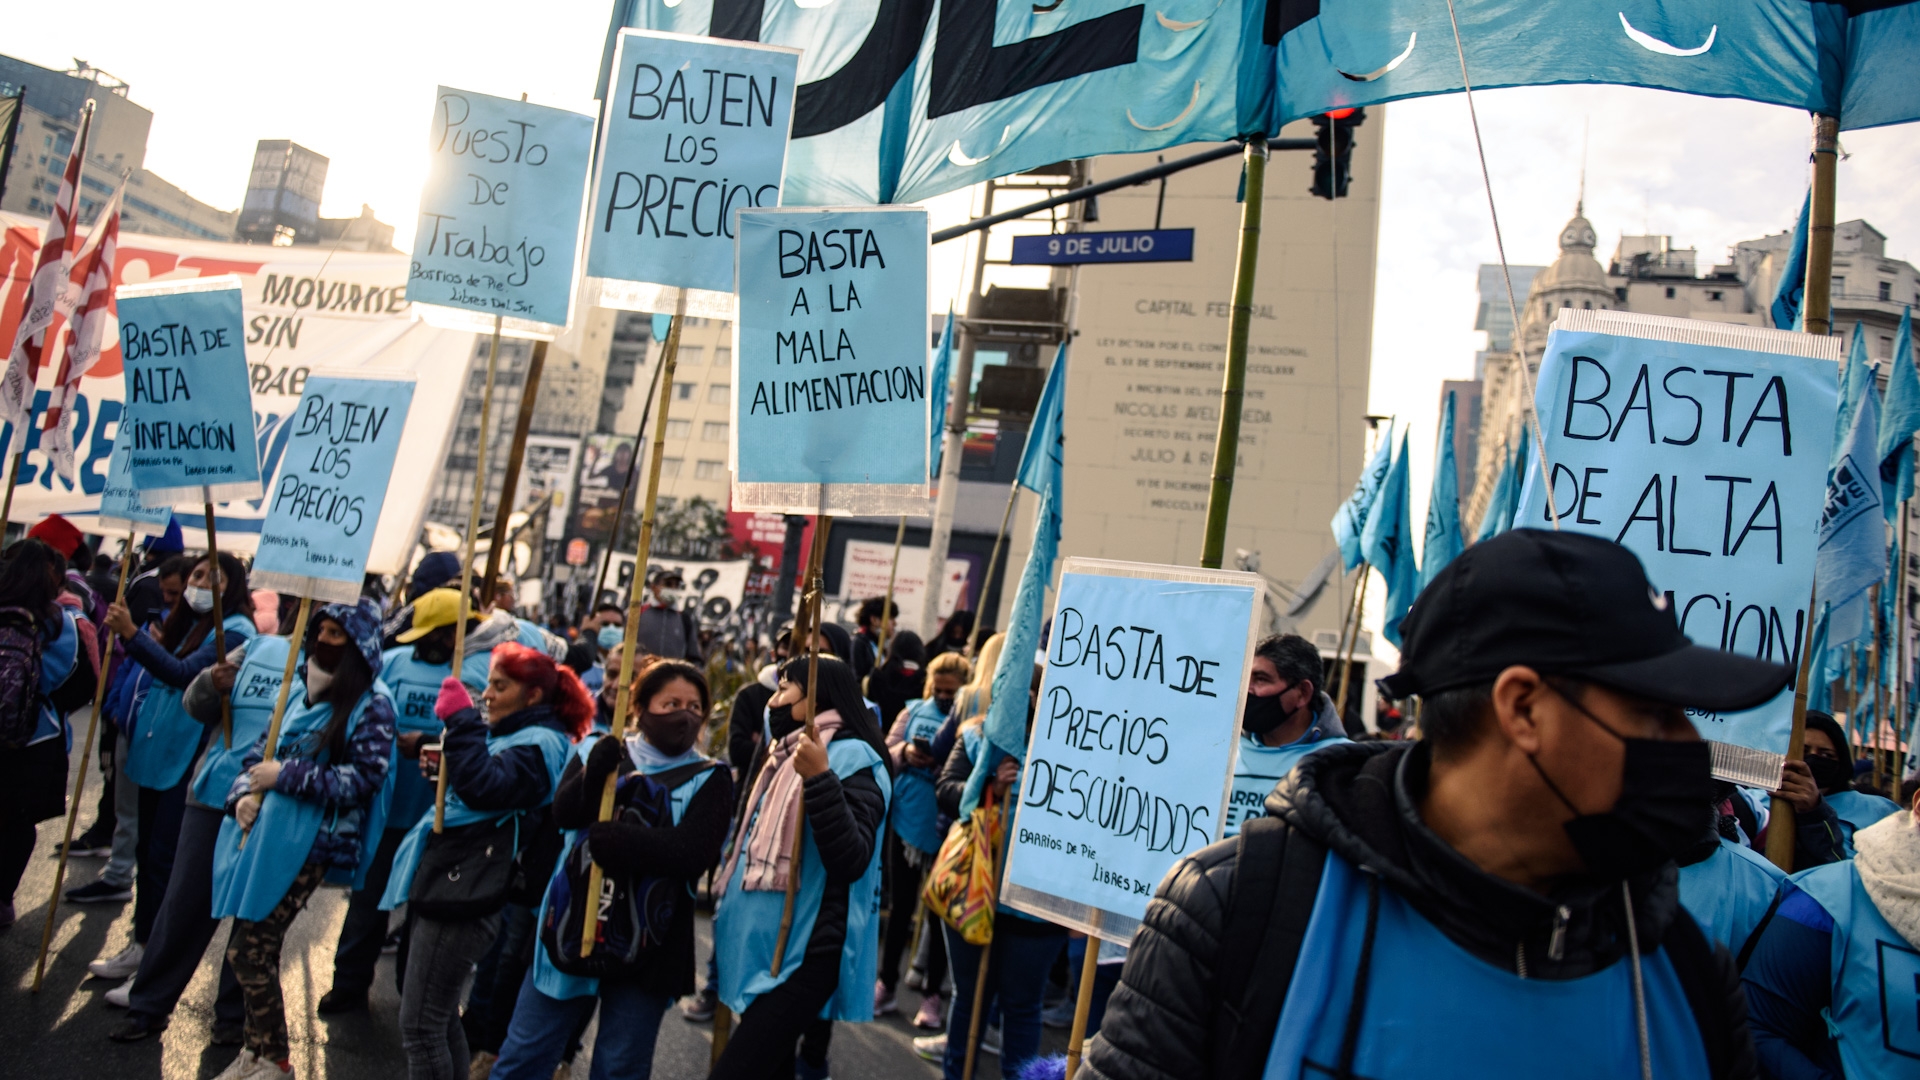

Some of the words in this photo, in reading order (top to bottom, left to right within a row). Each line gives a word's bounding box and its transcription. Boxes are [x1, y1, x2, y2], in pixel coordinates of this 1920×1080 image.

[628, 63, 778, 128] BAJEN
[663, 133, 718, 166] LOS
[422, 212, 545, 287] Trabajo
[779, 228, 886, 279] BASTA
[1048, 239, 1061, 256] 9
[1065, 238, 1092, 255] DE
[1096, 235, 1155, 254] JULIO
[410, 261, 462, 284] Barrios
[466, 274, 481, 288] de
[262, 274, 415, 313] MOVIMIE
[449, 287, 487, 306] Libres
[790, 287, 810, 316] A
[829, 280, 862, 312] LA
[1134, 299, 1197, 317] CAPITAL
[122, 322, 197, 360] BASTA
[200, 328, 231, 351] DE
[247, 315, 303, 350] SIN
[776, 328, 856, 365] MALA
[1159, 341, 1179, 351] POR
[1137, 357, 1150, 368] DE
[132, 367, 191, 404] ALTA
[750, 365, 925, 416] ALIMENTACION
[295, 394, 389, 445] BAJEN
[1114, 401, 1178, 419] NICOLAS
[1563, 355, 1793, 457] BASTA
[310, 445, 351, 480] LOS
[1130, 447, 1175, 464] JULIO
[1183, 449, 1193, 465] A
[1543, 462, 1609, 525] DE
[1614, 473, 1784, 565] ALTA
[1049, 606, 1165, 685] BASTA
[1169, 655, 1221, 698] DE
[243, 686, 273, 699] DE
[405, 703, 432, 719] DE
